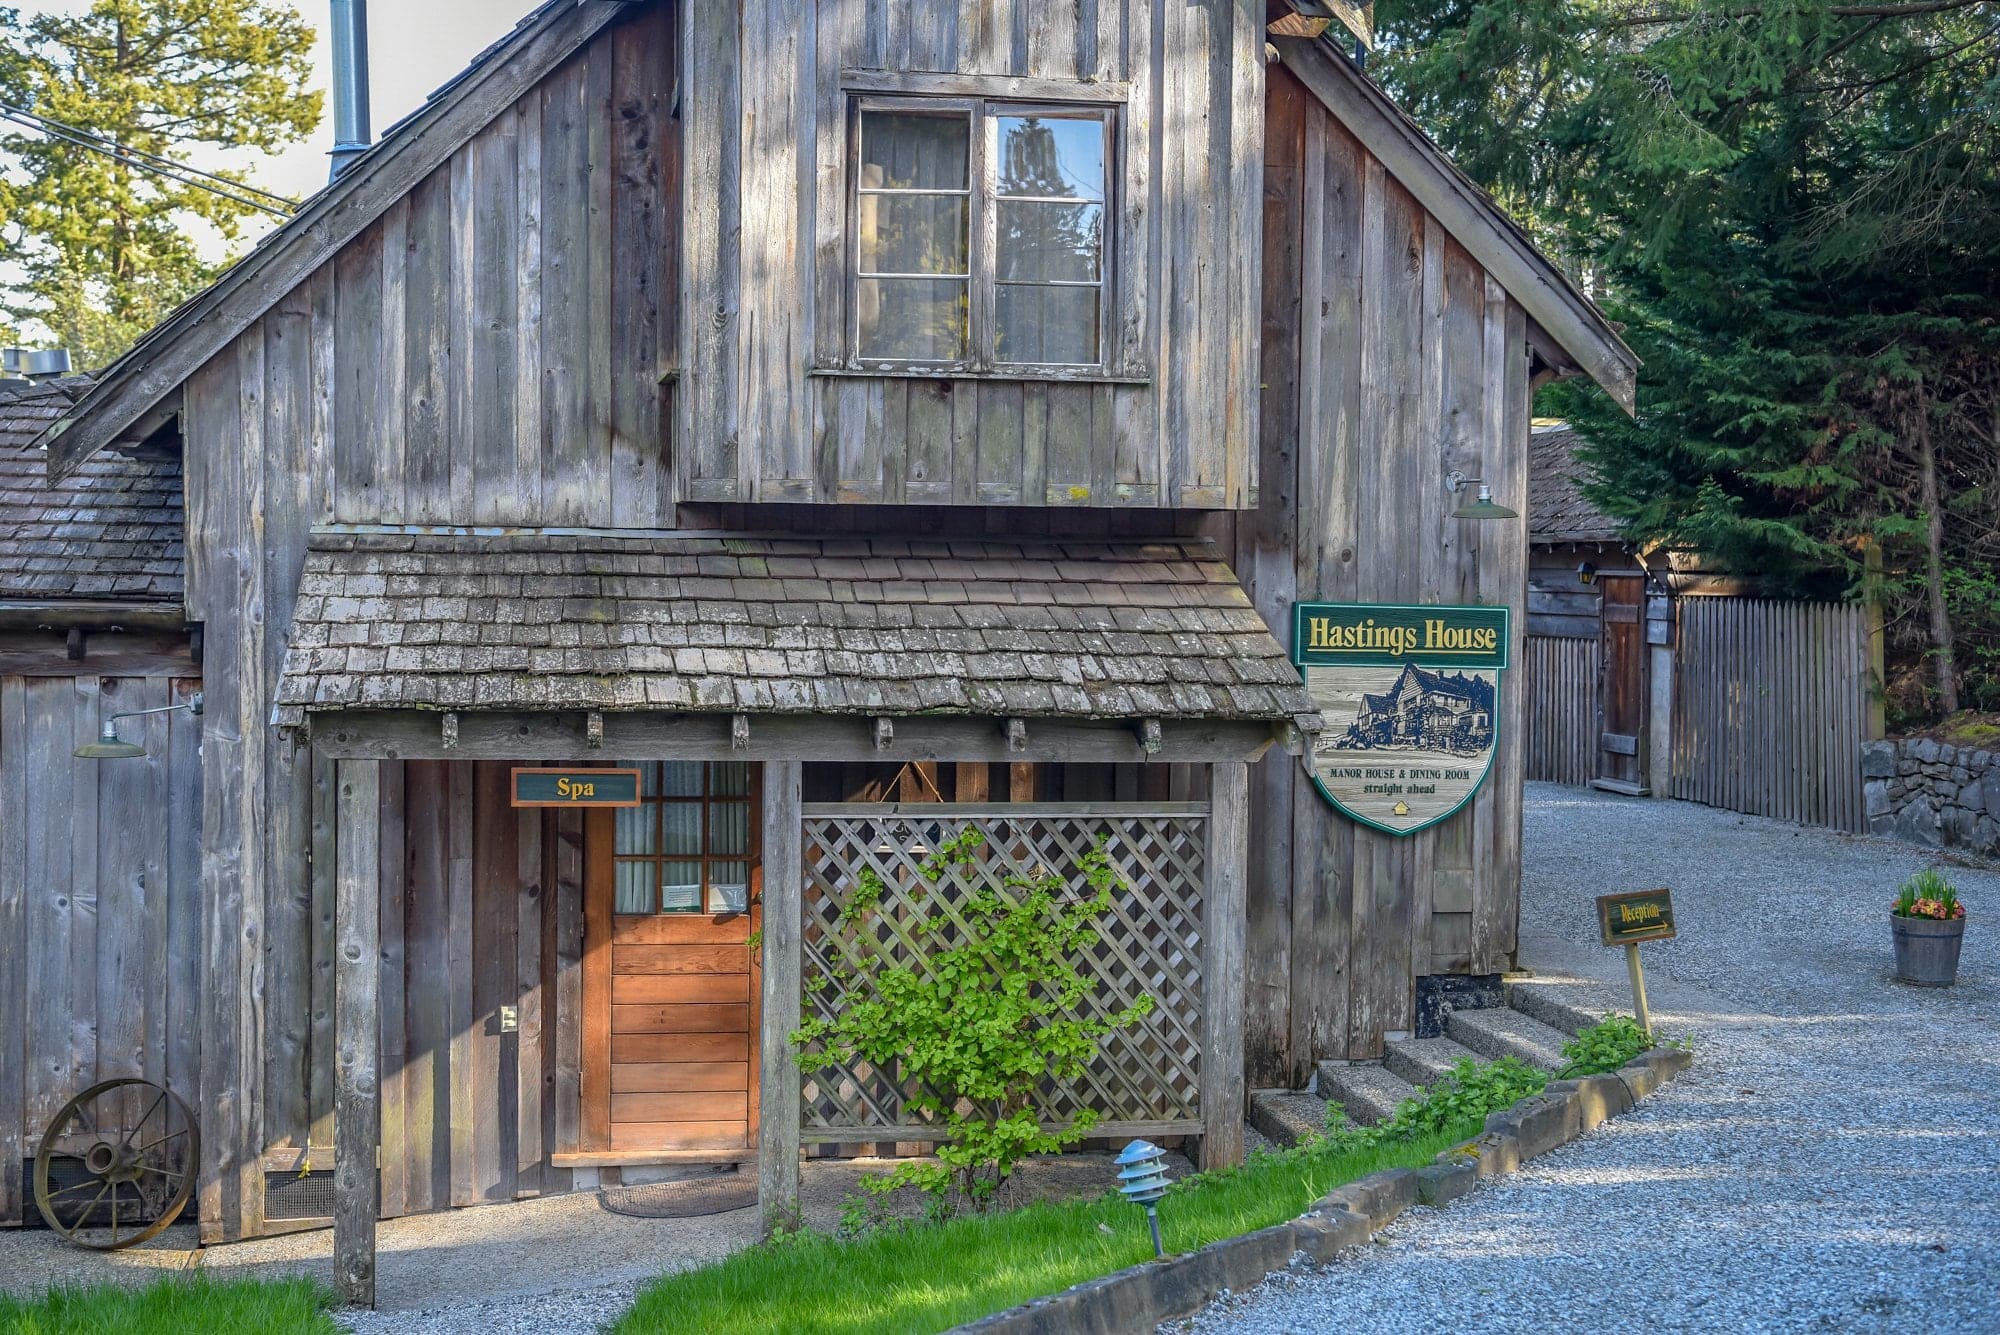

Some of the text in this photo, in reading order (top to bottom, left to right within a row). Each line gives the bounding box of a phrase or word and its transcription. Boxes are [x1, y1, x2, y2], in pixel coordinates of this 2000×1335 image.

[1308, 617, 1497, 656] Hastings House
[1330, 768, 1470, 780] MANOR HOUSE & DINING ROOM
[557, 777, 595, 801] Spa
[1363, 783, 1436, 795] straight ahead
[1621, 903, 1660, 923] Reception
